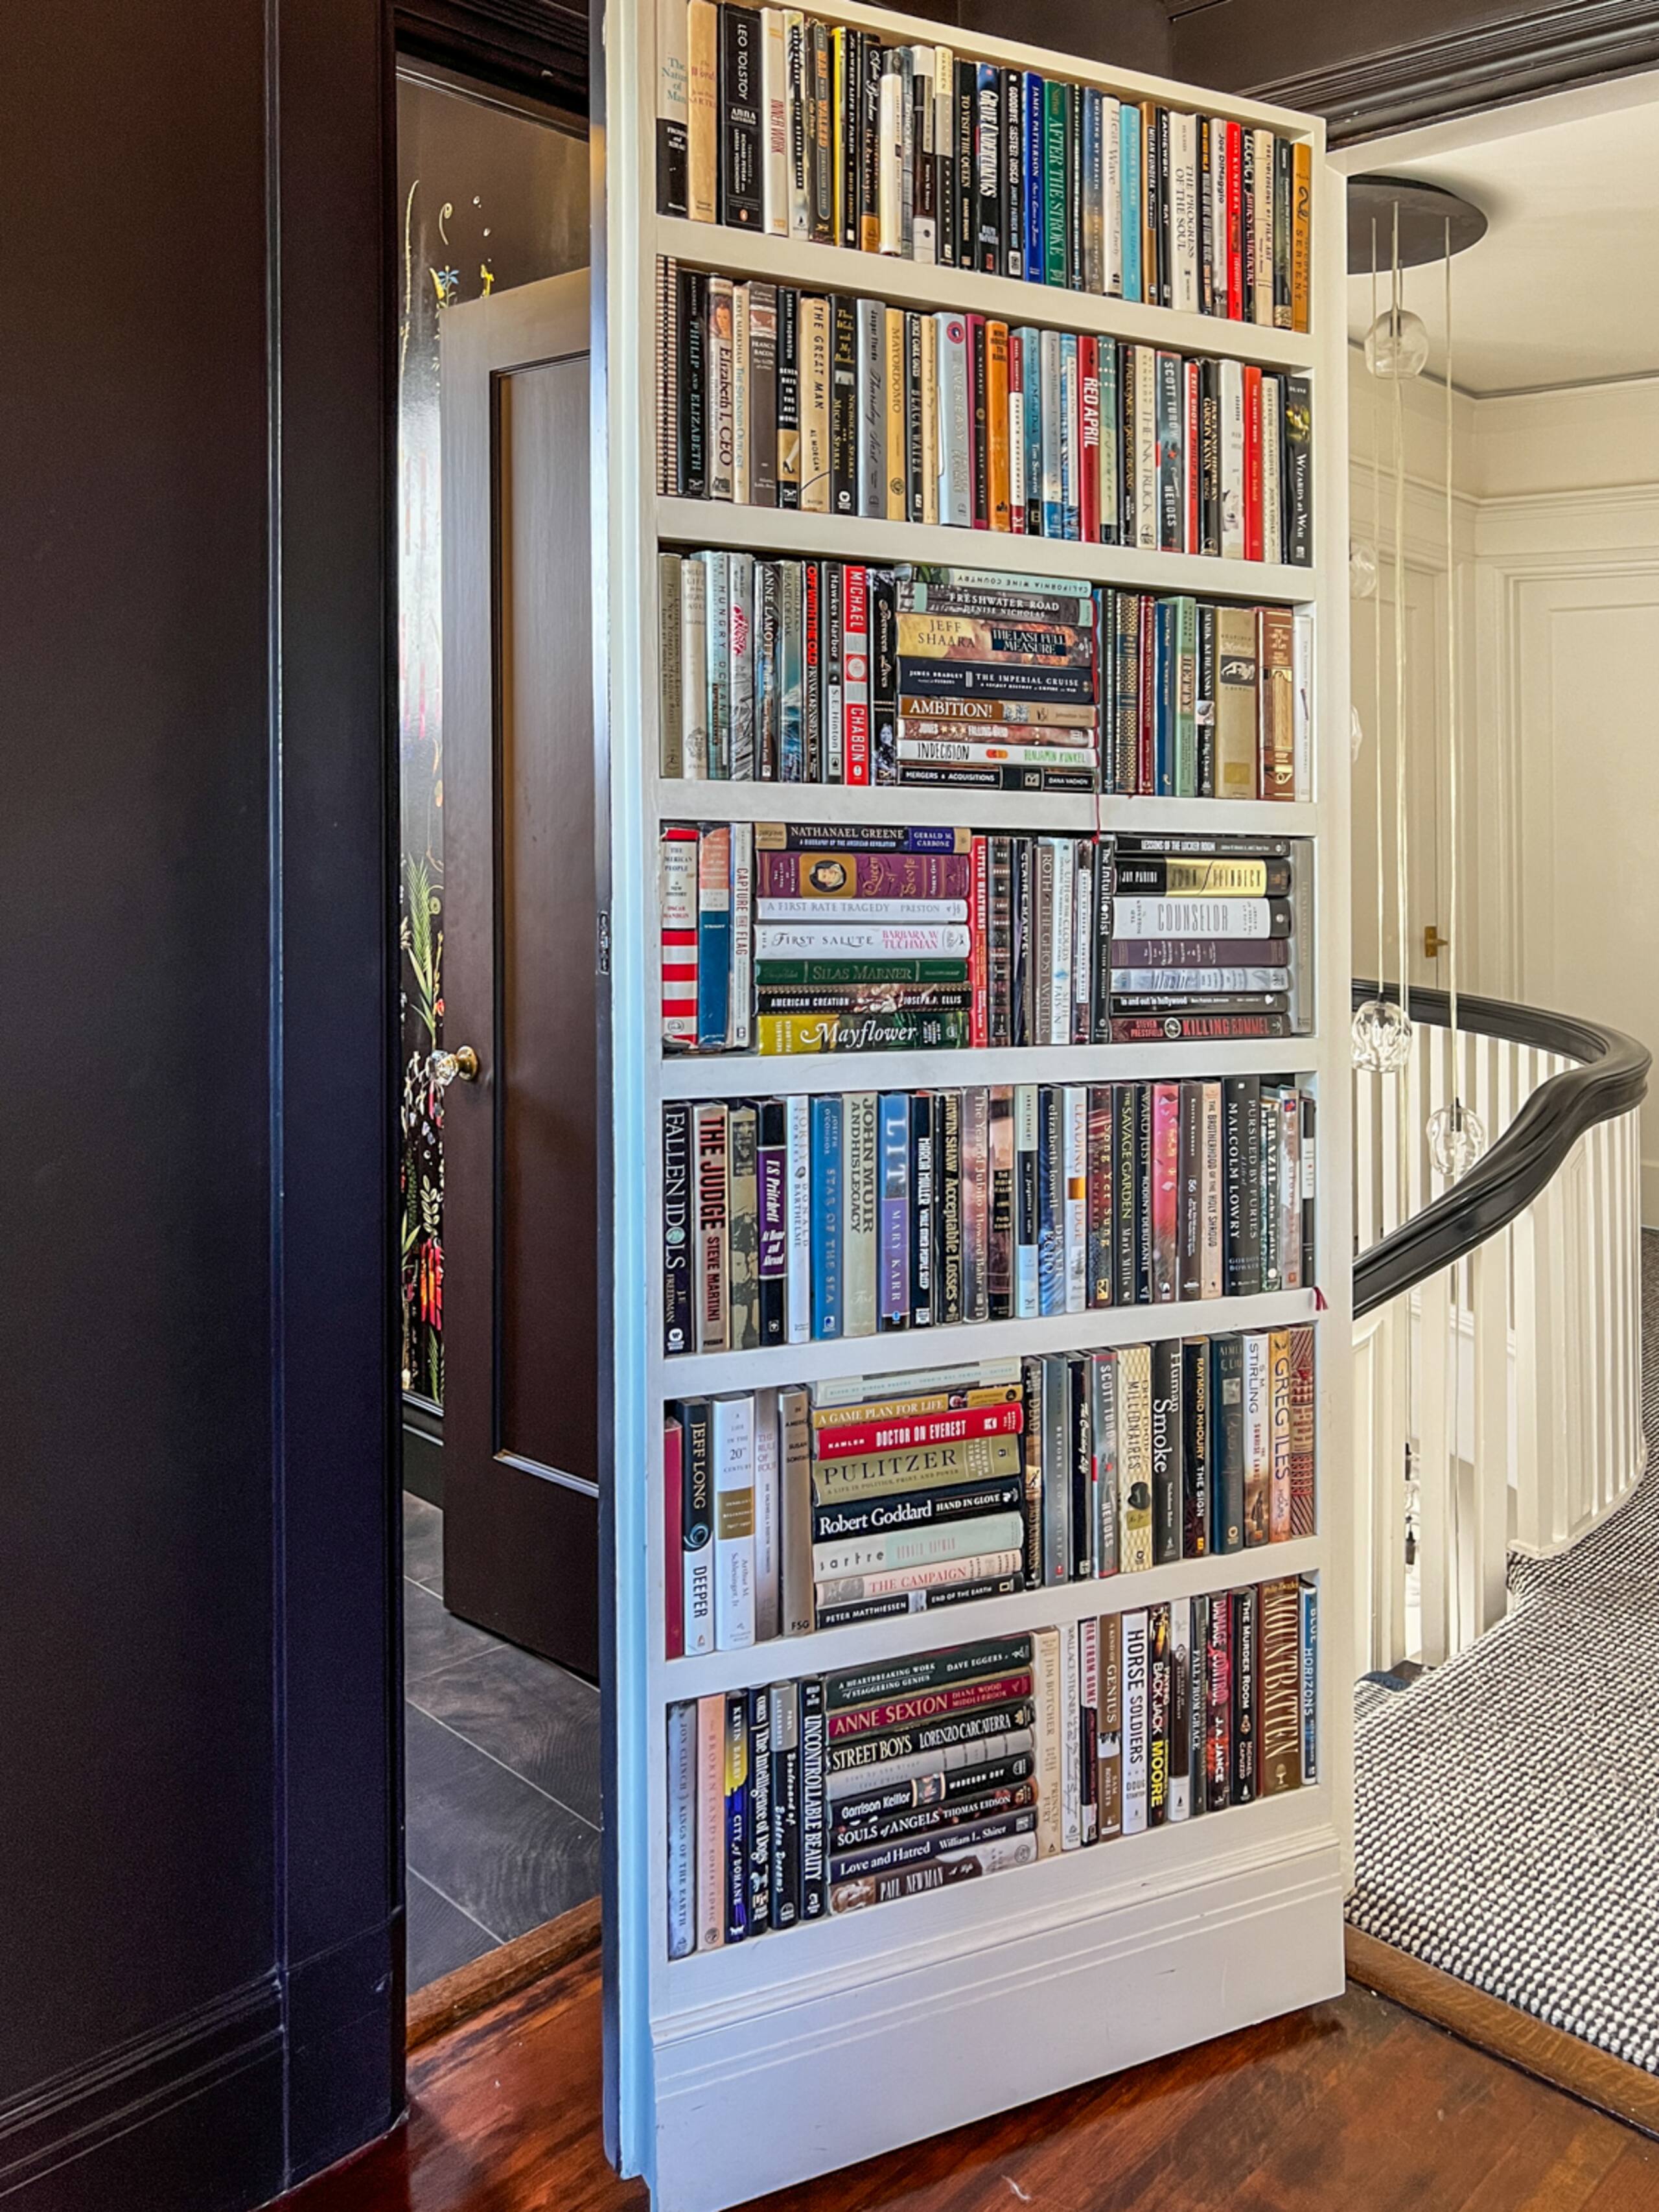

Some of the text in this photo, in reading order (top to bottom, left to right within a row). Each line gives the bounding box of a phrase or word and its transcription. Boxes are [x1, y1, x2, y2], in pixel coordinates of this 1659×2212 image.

[737, 24, 748, 100] LEO TOLSTOY
[771, 99, 785, 156] INNER WORK
[960, 95, 971, 187] TO VISIT THE QUEEN
[979, 90, 998, 198] GRAVE UNDERTAKINGS
[1008, 87, 1019, 183] GOODBYE SISTER DISCO
[1049, 117, 1063, 256] AFTER THE STROKE
[690, 321, 700, 368] PHILIP
[813, 305, 824, 410] THE GREAT MAN
[891, 327, 901, 413] MAYORDOMO
[719, 346, 732, 408] Elizabeth
[690, 393, 701, 471] ELIZABETH
[1083, 377, 1098, 448] RED APRIL
[719, 426, 732, 466] CEO
[1142, 410, 1153, 513] THE INK TRUCK
[764, 568, 773, 658] ANNE LAMOTT
[830, 574, 839, 616] Hawkes
[949, 593, 1059, 611] FRESHWATER ROAD
[957, 575, 1089, 594] CALIFORNIA WINE COUNTRY
[831, 619, 839, 658] Harbor
[918, 620, 975, 648] JEFF SHAARA
[850, 570, 865, 762] MICHAEL CHABON
[976, 673, 1079, 686] THE IMPERIAL CRUISE
[831, 711, 839, 749] Hinton
[909, 699, 993, 718] AMBITION!
[917, 742, 970, 760] INDECISION
[948, 773, 995, 782] ACQUISITIONS
[791, 826, 859, 837] NATHANAEL
[861, 828, 904, 839] GREENE
[1102, 848, 1111, 864] The
[736, 867, 749, 911] CAPTURE
[778, 902, 806, 912] FIRST
[811, 902, 837, 913] RATE
[842, 902, 890, 913] TRAGEDY
[736, 916, 748, 929] THE
[736, 931, 748, 956] FLAG
[771, 932, 873, 947] FIRST SALUTE
[1157, 904, 1228, 932] COUNSELOR
[813, 966, 849, 979] SILAS
[853, 965, 911, 979] MARNER
[800, 1019, 916, 1047] Mayflower
[665, 1112, 686, 1196] FALLEN
[863, 1097, 874, 1233] JOHN MUIR
[918, 1137, 929, 1205] MARCIA MULLER
[1229, 1102, 1240, 1239] MALCOLM LOWRY
[1248, 1099, 1257, 1239] PURSUED BY FURIES
[700, 1116, 725, 1322] THE JUDGE STEVE MARTINI
[885, 1117, 906, 1301] LIT MARY KARR
[942, 1099, 958, 1300] IRWIN SHAW Acceptable Losses
[818, 1399, 944, 1424] A GAME PLAN FOR LIFE
[876, 1419, 966, 1447] DOCTOR ON EVEREST
[1154, 1351, 1181, 1474] Human Smoke
[1196, 1358, 1204, 1516] RAYMOND KHOURY THE SIGN
[1274, 1357, 1288, 1480] GREG ILES
[690, 1422, 706, 1509] JEFF LONG
[823, 1448, 957, 1485] PULITZER
[818, 1493, 1001, 1535] Robert Goddard HAND IN GLOVE
[692, 1566, 708, 1619] DEEPER
[791, 1621, 809, 1631] FSG
[1242, 1599, 1251, 1709] THE MURDER ROOM
[1127, 1629, 1144, 1764] HORSE SOLDIERS
[1152, 1661, 1163, 1735] BACK JACK
[1263, 1593, 1298, 1760] MOUNTBATTEN
[832, 1714, 1012, 1771] STREET BOYS LORENZO CARCATERRA
[835, 1694, 948, 1736] ANNE SEXTON
[750, 1728, 770, 1863] The Intelligence of Dogs
[804, 1714, 822, 1880] UNCONTROLLABLE BEAUTY
[1151, 1740, 1163, 1807] MOORE
[837, 1809, 940, 1846] SOULS of ANGELS
[841, 1792, 911, 1819] Garrison Keillor
[839, 1841, 931, 1876] Love and Hatred
